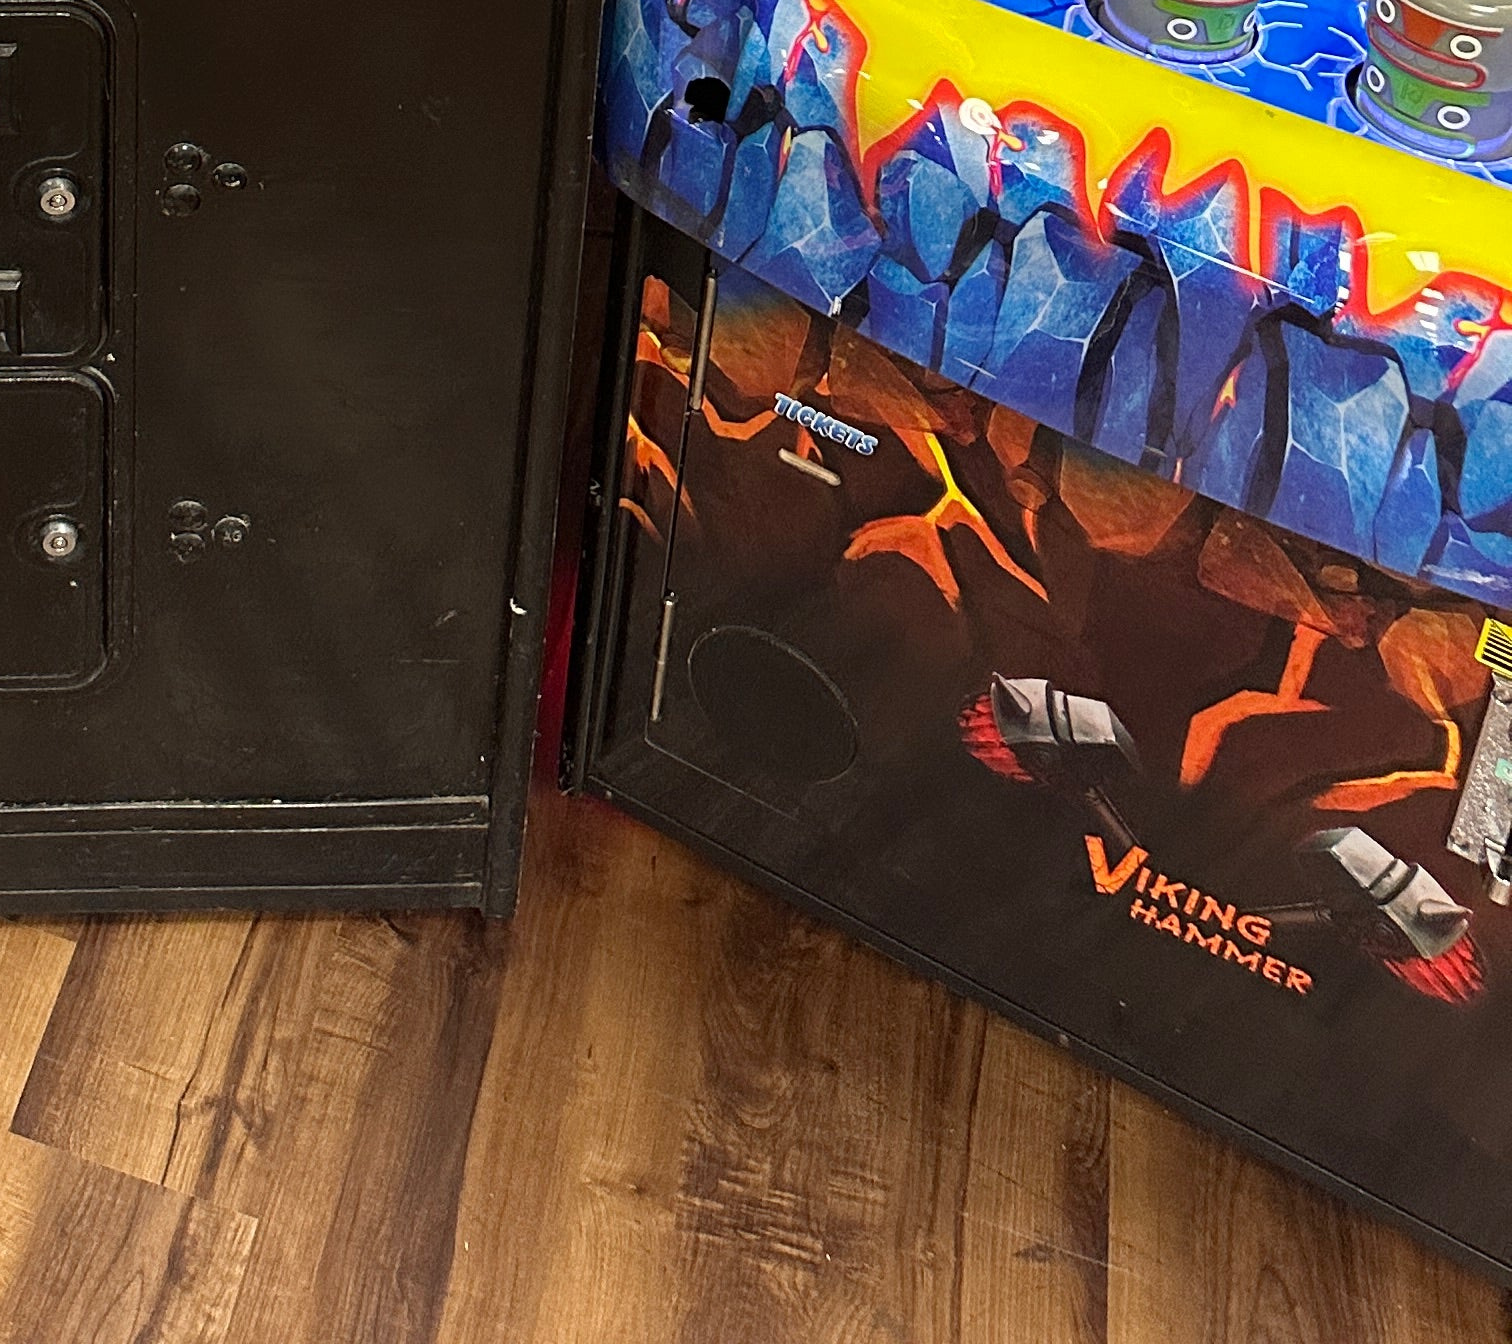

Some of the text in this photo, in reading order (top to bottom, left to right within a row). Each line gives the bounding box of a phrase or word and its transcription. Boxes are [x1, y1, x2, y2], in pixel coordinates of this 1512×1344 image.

[774, 392, 879, 455] TICKETS
[1084, 834, 1272, 947] VIKING
[1129, 898, 1314, 995] HAMMER
